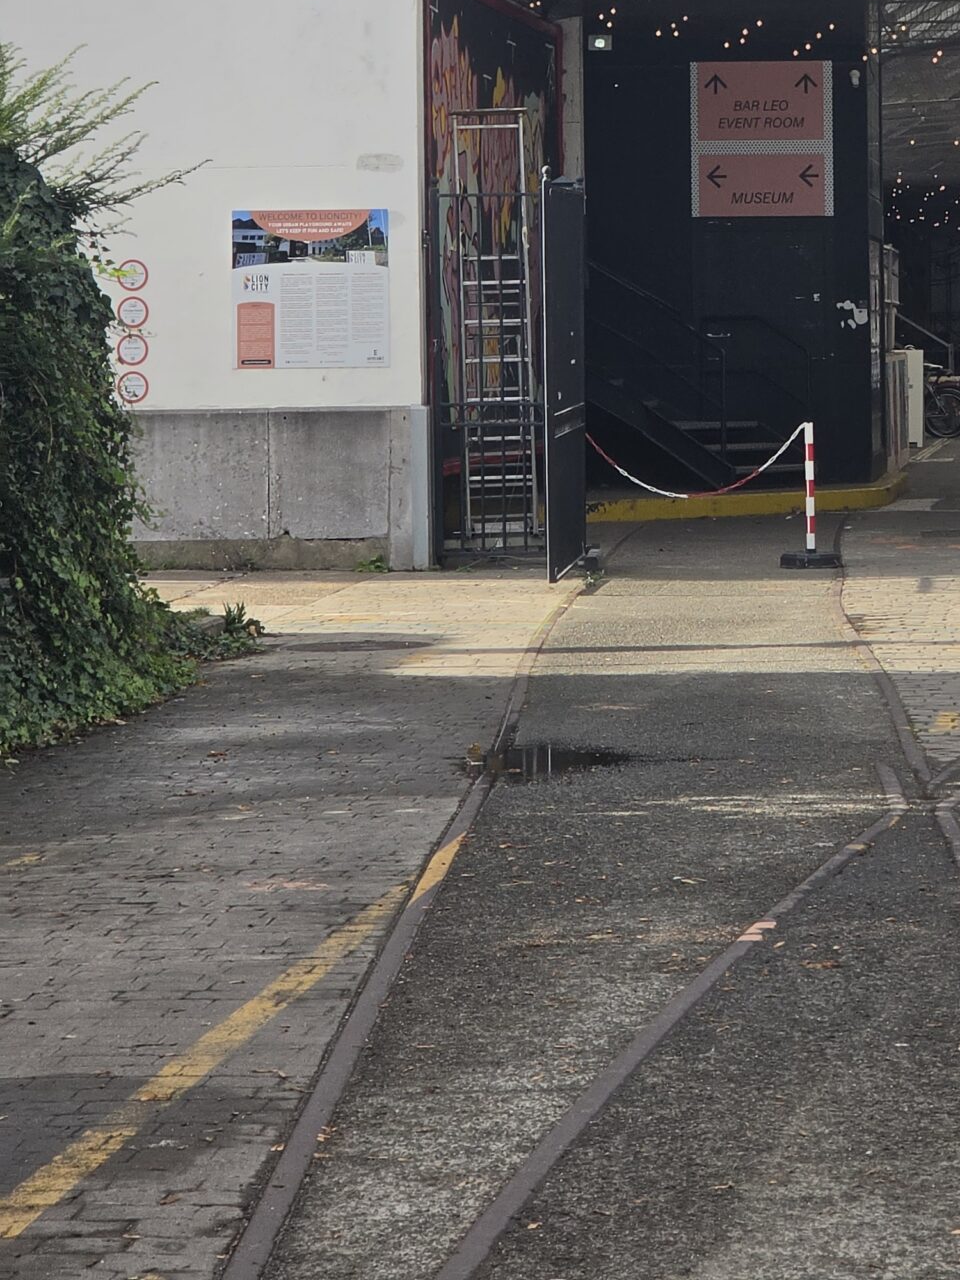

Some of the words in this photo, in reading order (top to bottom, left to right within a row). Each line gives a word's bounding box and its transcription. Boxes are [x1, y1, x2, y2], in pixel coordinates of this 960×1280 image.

[733, 100, 760, 111] BAR
[763, 100, 789, 111] LEO
[718, 117, 761, 128] EVENT
[764, 117, 805, 128] ROOM
[731, 191, 794, 204] MUSEUM
[259, 212, 303, 221] WELCOME
[306, 212, 317, 221] TO
[251, 283, 269, 291] CITY
